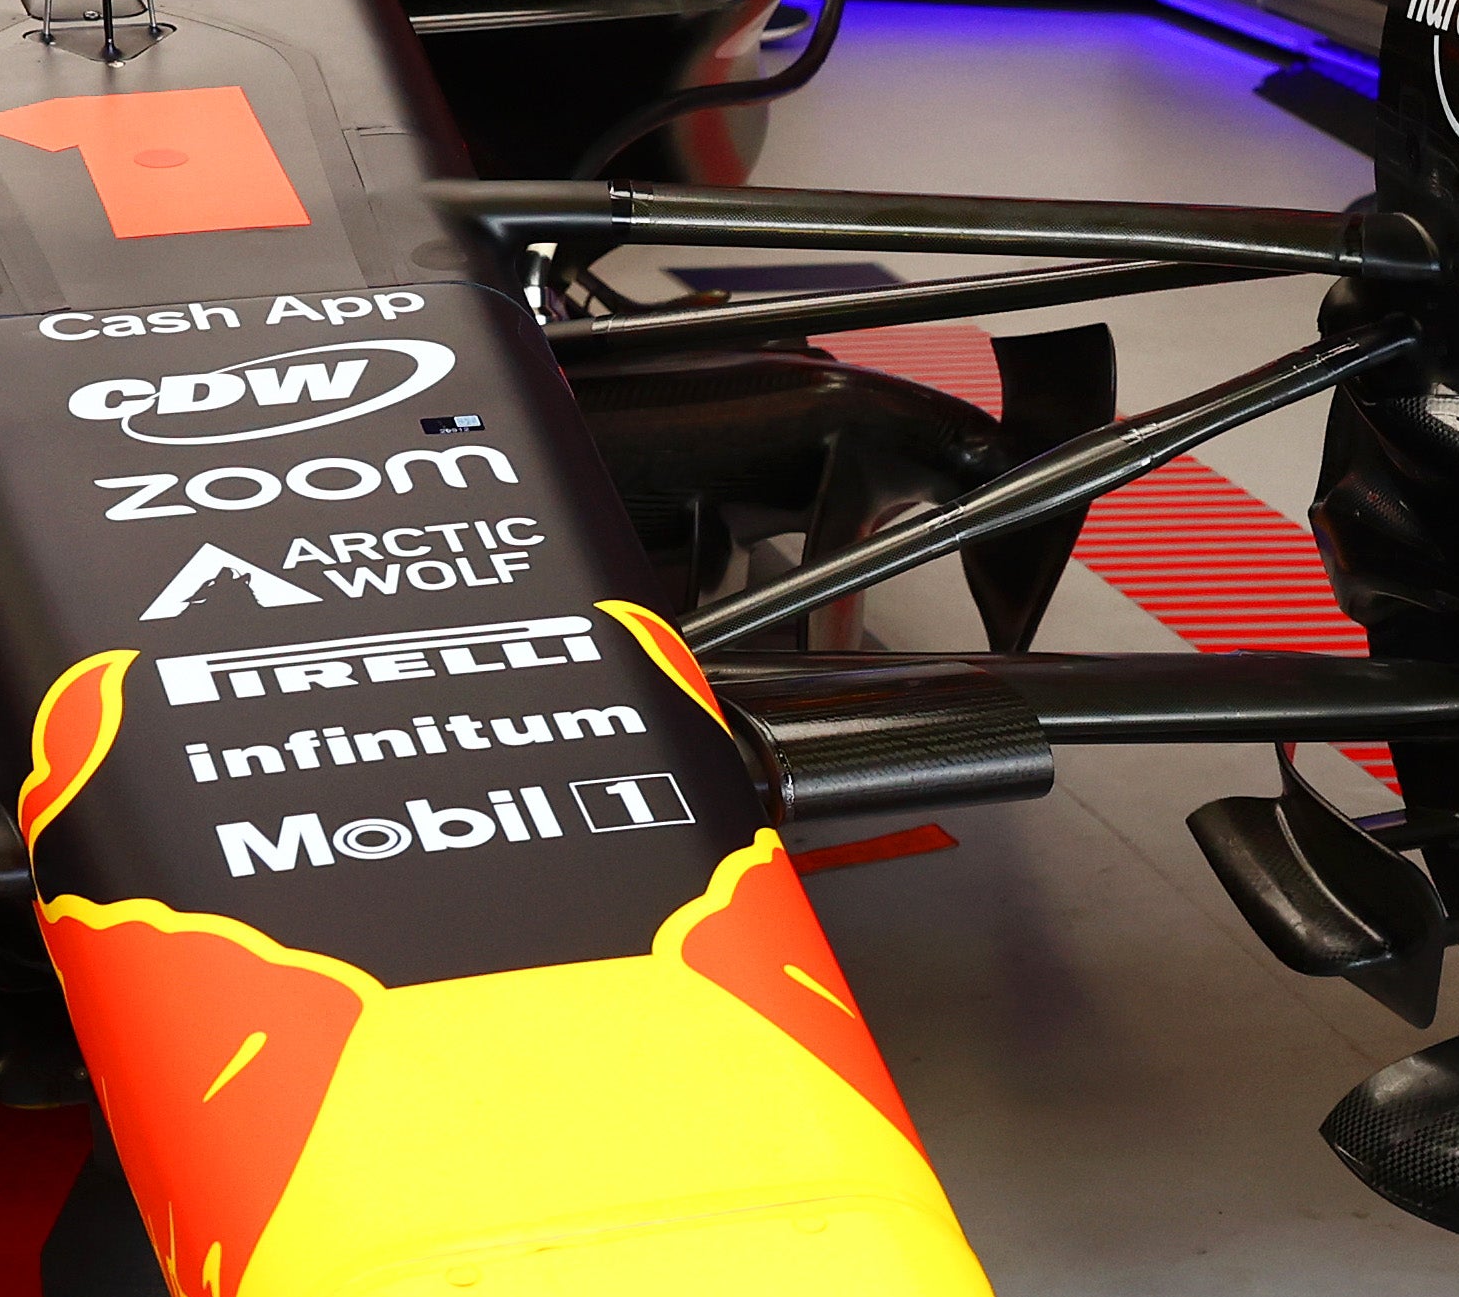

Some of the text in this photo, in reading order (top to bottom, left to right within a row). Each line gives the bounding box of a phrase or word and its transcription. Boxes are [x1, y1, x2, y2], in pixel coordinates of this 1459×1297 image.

[37, 288, 426, 342] Cash App
[68, 359, 370, 421] CDW
[93, 444, 520, 522] zoom
[282, 517, 546, 570] ARCTIC
[322, 552, 531, 600] WOLF
[154, 615, 603, 707] PIRELLI
[184, 704, 647, 784] infinitum
[214, 785, 566, 879] Mobil
